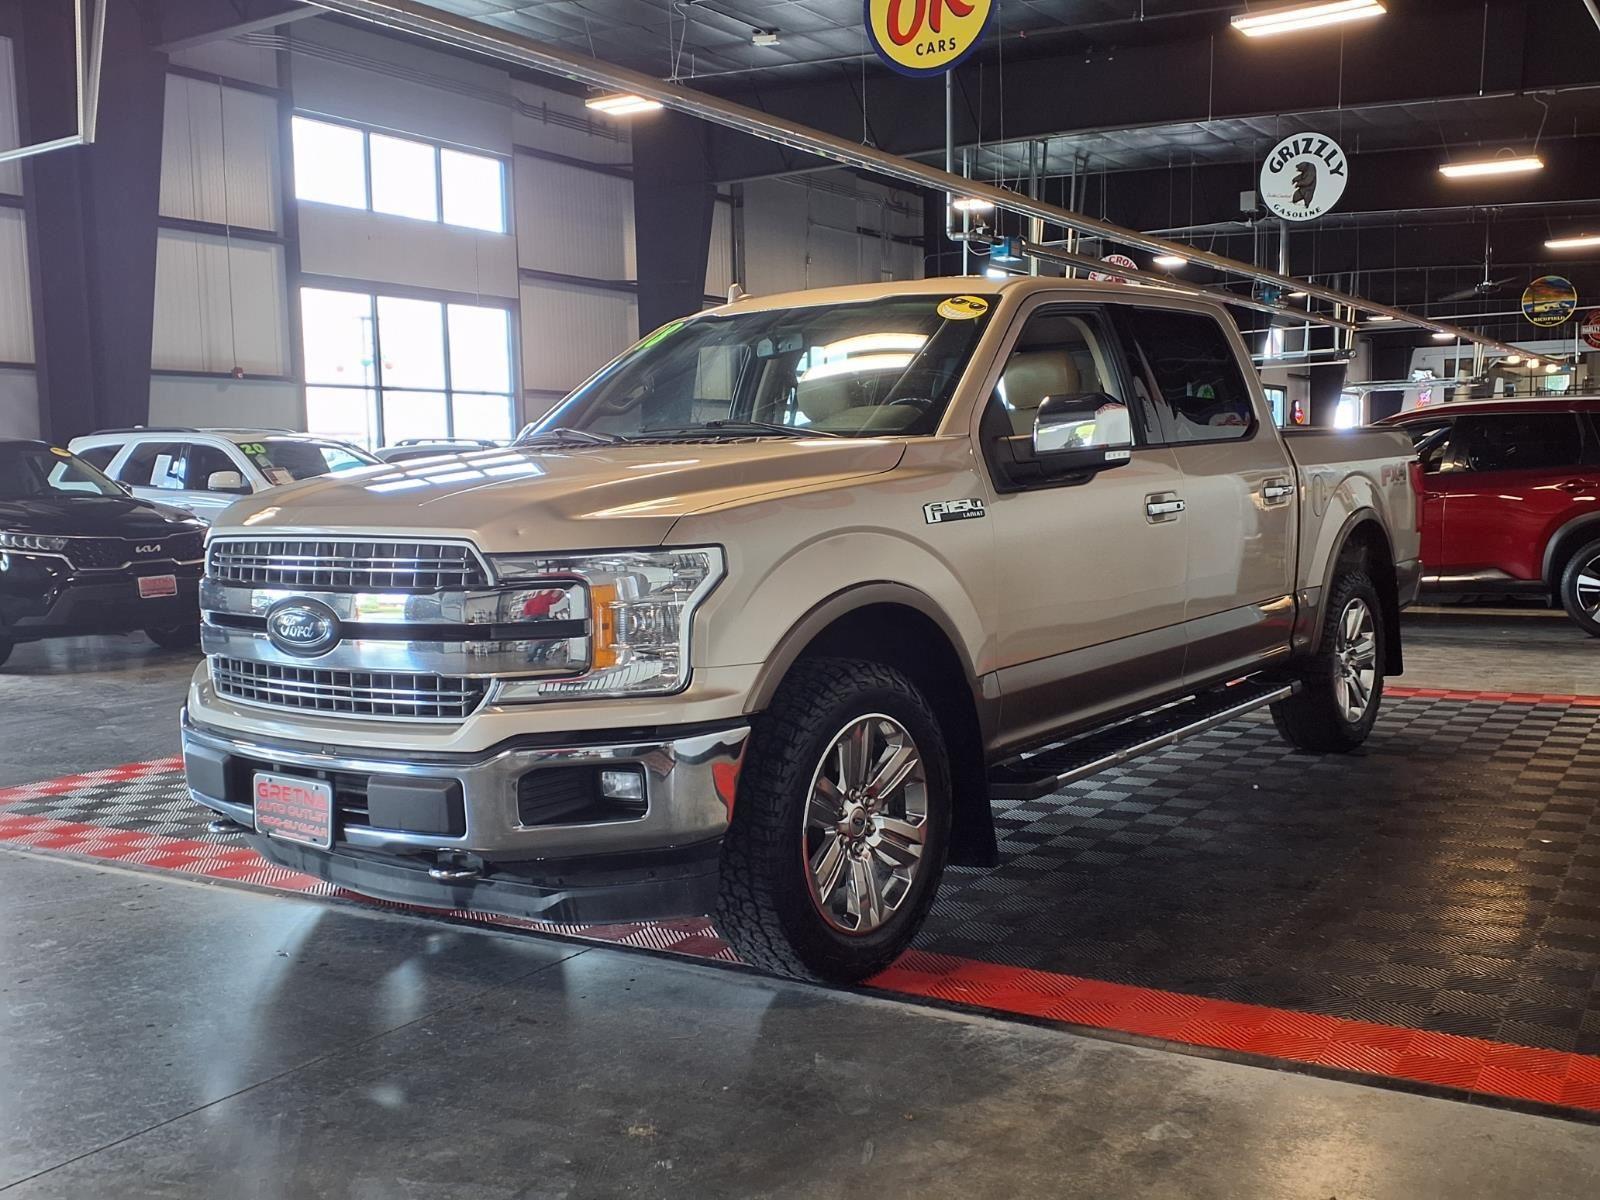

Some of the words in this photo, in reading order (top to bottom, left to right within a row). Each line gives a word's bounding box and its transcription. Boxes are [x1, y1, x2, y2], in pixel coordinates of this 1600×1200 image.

[915, 37, 957, 56] CARS
[1269, 138, 1344, 176] GRIZZLY
[1274, 203, 1322, 218] GASOLINE
[240, 443, 266, 454] 20
[277, 614, 315, 637] Ford
[257, 782, 328, 810] GRETNA
[257, 801, 286, 815] AUTO
[287, 805, 329, 823] OUTLET
